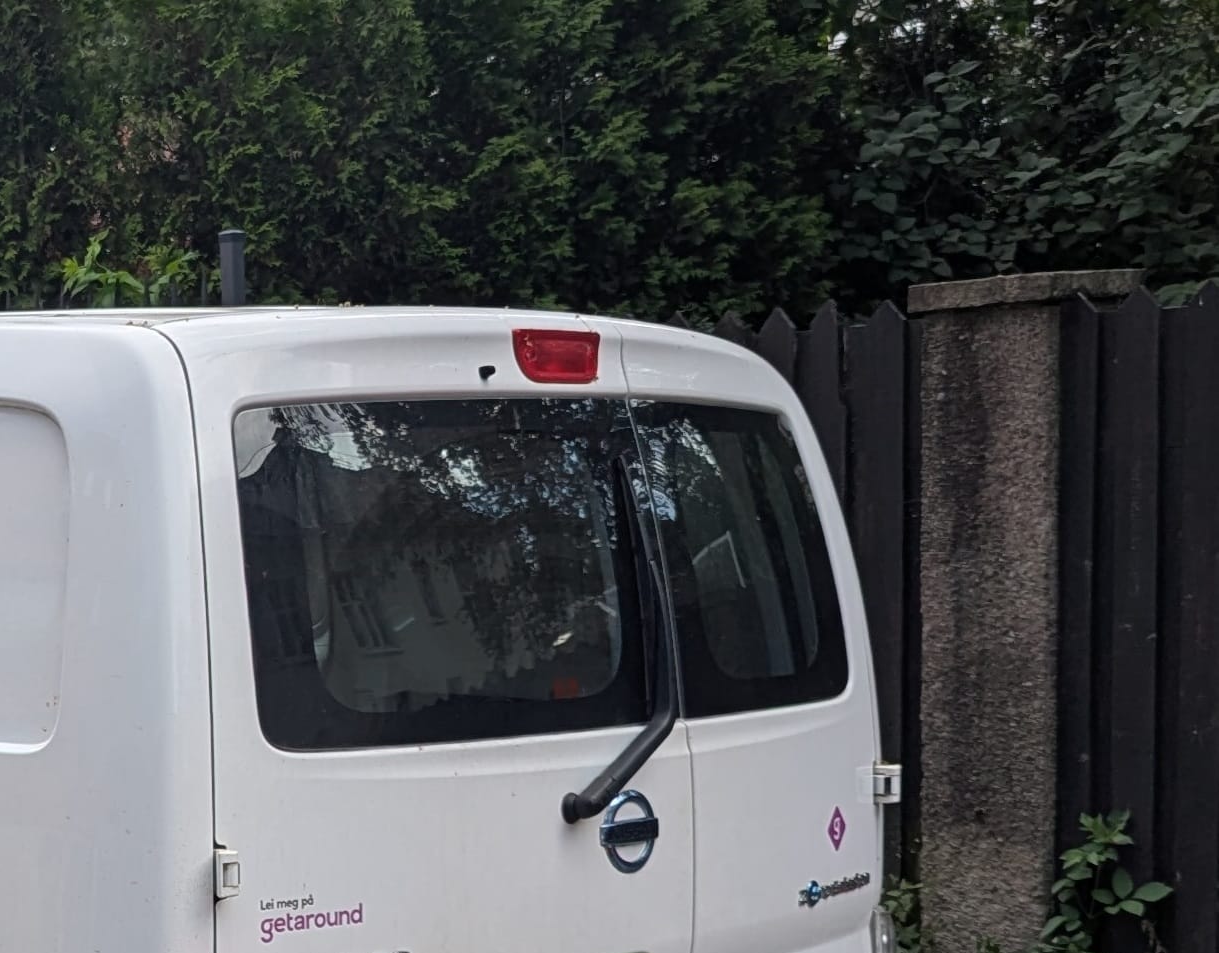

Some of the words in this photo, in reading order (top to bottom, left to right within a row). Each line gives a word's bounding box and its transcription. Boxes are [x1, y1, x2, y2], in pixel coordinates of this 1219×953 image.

[260, 898, 274, 911] Lei
[276, 898, 299, 911] meg
[301, 894, 314, 910] på
[260, 902, 363, 943] getaround
